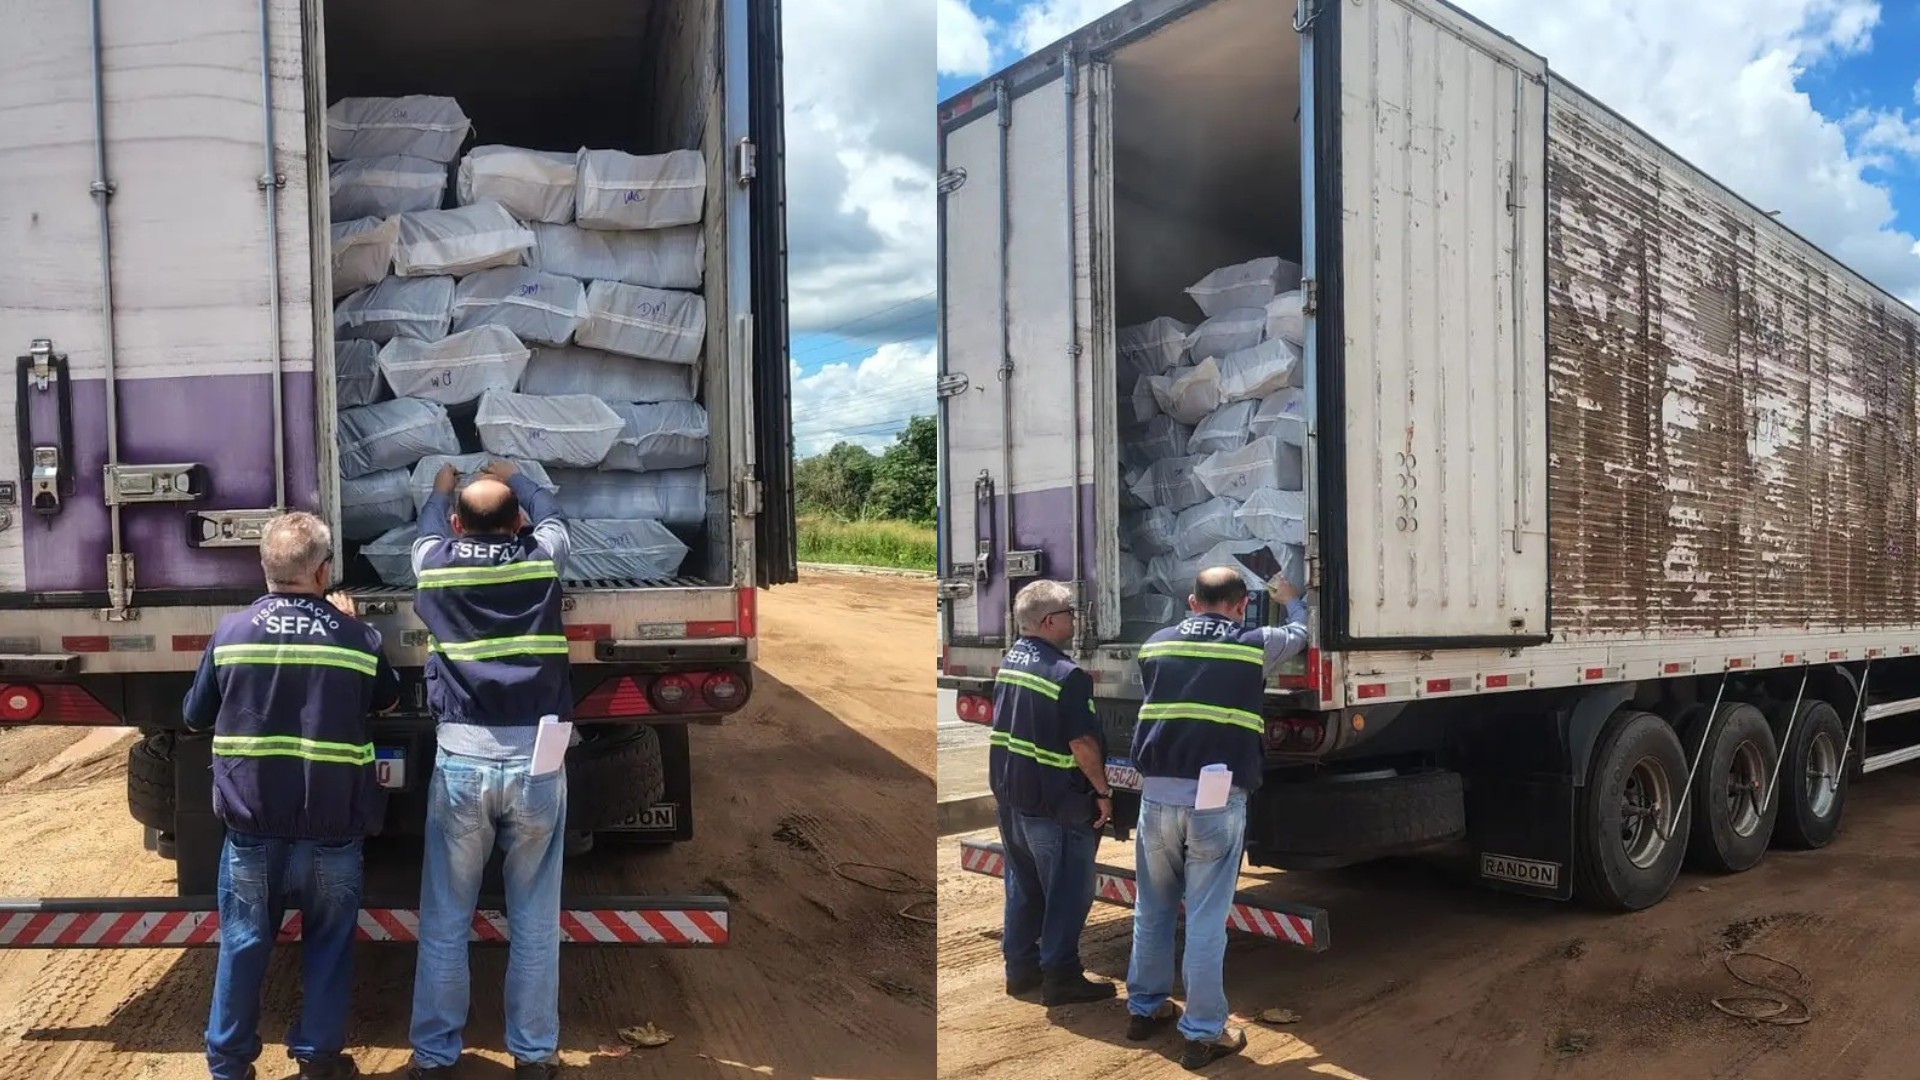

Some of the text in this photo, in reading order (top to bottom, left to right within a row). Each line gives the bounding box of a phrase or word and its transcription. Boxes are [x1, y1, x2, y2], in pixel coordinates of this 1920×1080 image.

[266, 616, 327, 636] SEFA
[1181, 621, 1226, 637] SEFA
[1007, 650, 1030, 666] SEFA
[1105, 766, 1139, 787] C5C20
[1486, 860, 1552, 882] RANDON
